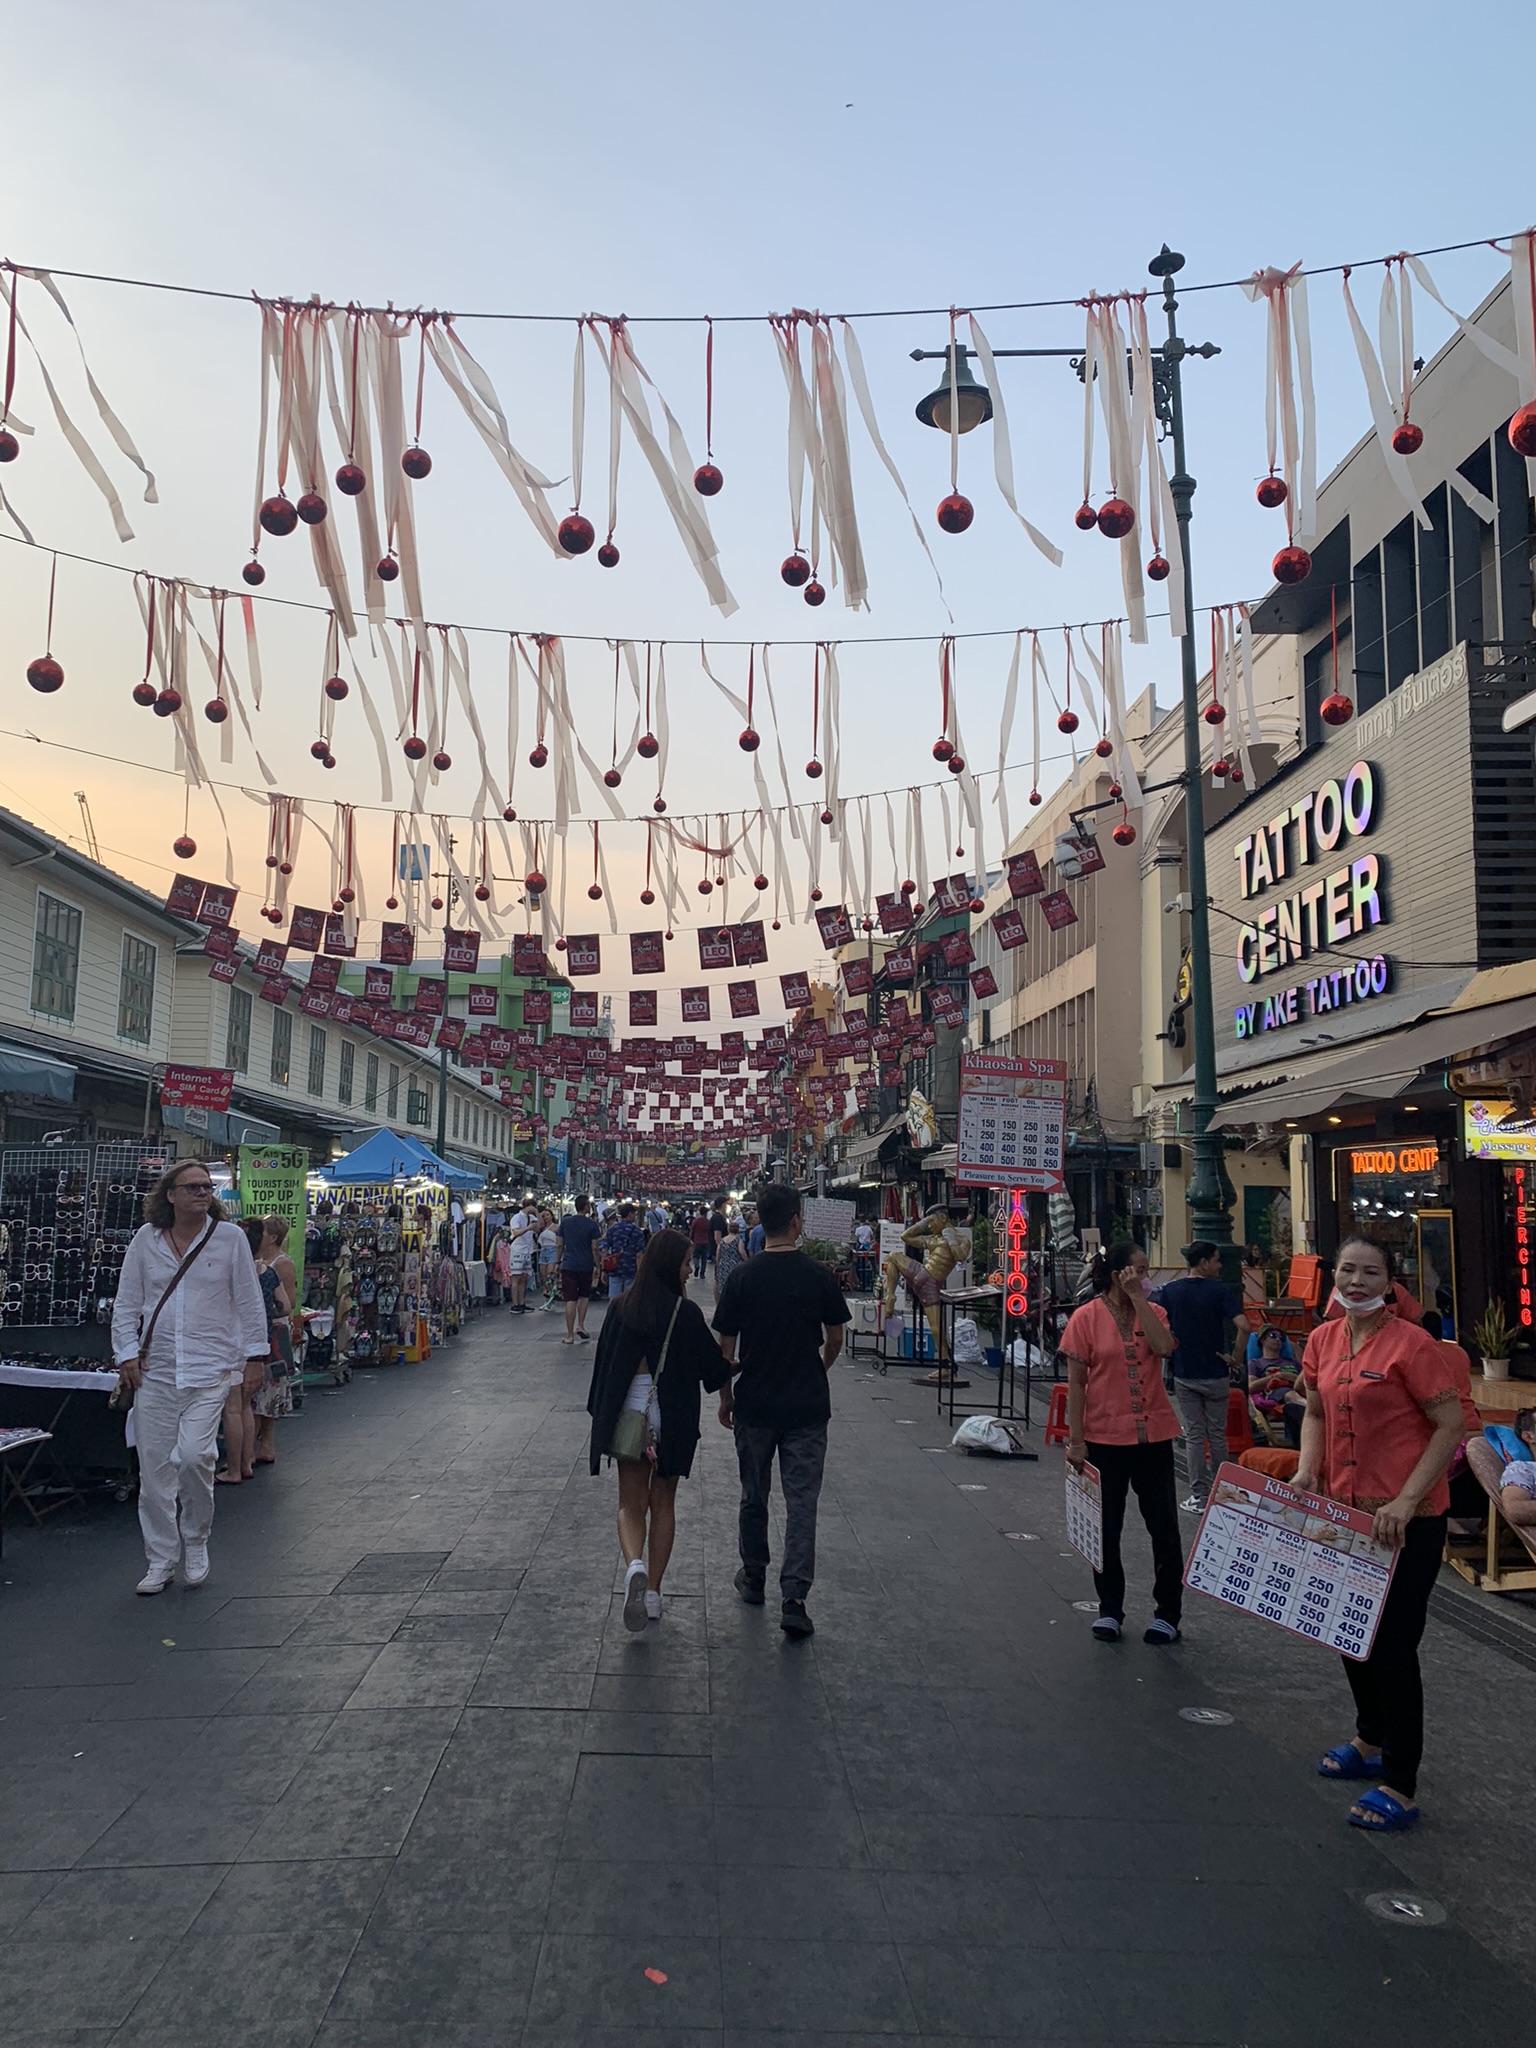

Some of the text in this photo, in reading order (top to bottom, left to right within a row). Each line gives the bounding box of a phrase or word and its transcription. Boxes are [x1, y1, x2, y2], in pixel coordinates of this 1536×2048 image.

[1234, 760, 1373, 900] TATTOO
[1079, 849, 1095, 862] EO
[943, 891, 966, 907] LO
[206, 904, 227, 917] LEO
[1237, 853, 1381, 983] CENTER
[825, 923, 848, 938] LEO
[1001, 927, 1021, 940] LEO
[450, 950, 472, 960] LEO
[573, 953, 595, 963] LEO
[705, 947, 727, 956] LEO
[216, 963, 234, 975] LEO
[261, 957, 280, 969] LEO
[890, 961, 910, 971] LEO
[370, 984, 387, 992] LEO
[787, 988, 806, 998] LEO
[472, 996, 491, 1005] LEO
[933, 996, 949, 1006] LEO
[1235, 954, 1387, 1039] BY AKE TATTOO
[310, 999, 327, 1009] LEO
[686, 1003, 705, 1011] LEO
[575, 1008, 593, 1017] LEO
[948, 1012, 962, 1021] LEO
[397, 1024, 415, 1034] LEO
[850, 1021, 866, 1032] LEO
[417, 1032, 428, 1042] EO
[768, 1039, 784, 1048] LEO
[874, 1035, 889, 1043] LEO
[492, 1041, 509, 1050] LEO
[675, 1045, 693, 1053] LEO
[965, 1055, 1054, 1077] Khaosan Spa
[171, 1071, 212, 1084] Internet
[179, 1083, 220, 1094] SIM Card
[981, 1119, 995, 1128] 150
[1003, 1121, 1016, 1129] 150
[1024, 1122, 1038, 1131] 250
[1045, 1124, 1059, 1133] 180
[963, 1130, 1058, 1145] 1 250 250 400 300
[980, 1143, 994, 1152] 400
[1001, 1144, 1016, 1153] 400
[1023, 1146, 1037, 1155] 550
[1044, 1147, 1058, 1157] 450
[1481, 1140, 1530, 1153] Massage
[281, 1150, 303, 1169] 5G
[962, 1153, 1058, 1168] 2 500 500 700 550
[1351, 1152, 1396, 1174] TATTOO
[247, 1180, 299, 1188] TOURIST SIM
[964, 1171, 1045, 1184] Pleasure to Serve You
[252, 1190, 293, 1201] TOP UP
[395, 1188, 446, 1207] HENNA
[246, 1204, 300, 1215] INTERNET
[1007, 1189, 1028, 1316] TATTOO
[1514, 1167, 1533, 1326] PIERCING
[1264, 1480, 1350, 1523] Khaoan Spa
[1221, 1511, 1237, 1521] Type
[1208, 1521, 1224, 1532] Time
[1245, 1517, 1268, 1531] THAI
[1279, 1530, 1307, 1546] FOOT
[1322, 1547, 1339, 1559] OIL
[1239, 1522, 1270, 1538] MASSAGE
[1313, 1552, 1345, 1568] MASSAGE
[1235, 1546, 1259, 1564] 150
[1272, 1561, 1295, 1578] 150
[1308, 1576, 1334, 1594] 250
[1348, 1592, 1373, 1610] 180
[1203, 1549, 1210, 1559] 1
[1229, 1560, 1255, 1578] 250
[1265, 1574, 1291, 1593] 250
[1303, 1591, 1330, 1609] 400
[1342, 1606, 1369, 1625] 300
[1225, 1574, 1250, 1591] 400
[1261, 1590, 1287, 1607] 400
[1299, 1604, 1325, 1623] 550
[1338, 1621, 1365, 1640] 450
[1191, 1576, 1201, 1587] 2
[1220, 1587, 1245, 1606] 500
[1256, 1602, 1282, 1621] 500
[1295, 1618, 1321, 1637] 700
[1334, 1635, 1361, 1654] 550
